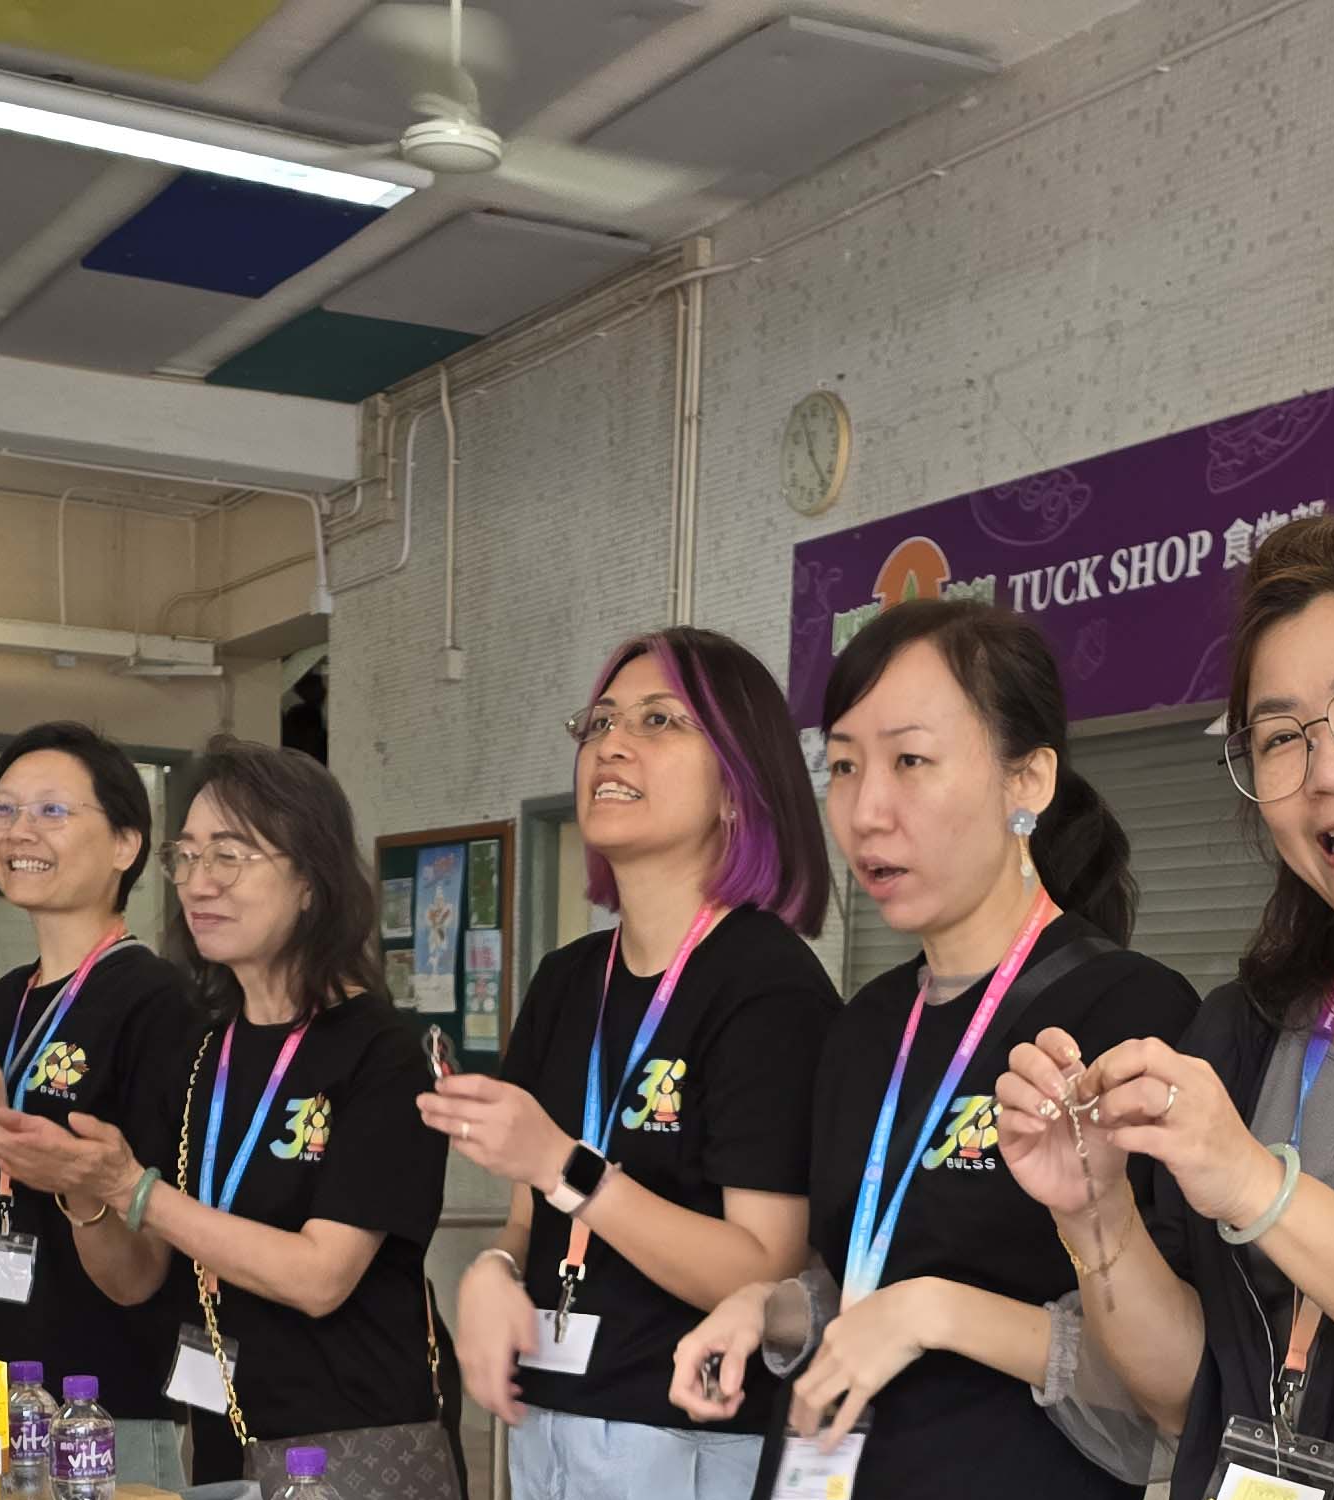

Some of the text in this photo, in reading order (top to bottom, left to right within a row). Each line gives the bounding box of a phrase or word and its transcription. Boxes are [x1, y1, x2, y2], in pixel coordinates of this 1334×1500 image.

[1007, 554, 1104, 614] TUCK
[1108, 529, 1214, 595] SHOP
[68, 1440, 115, 1470] vita
